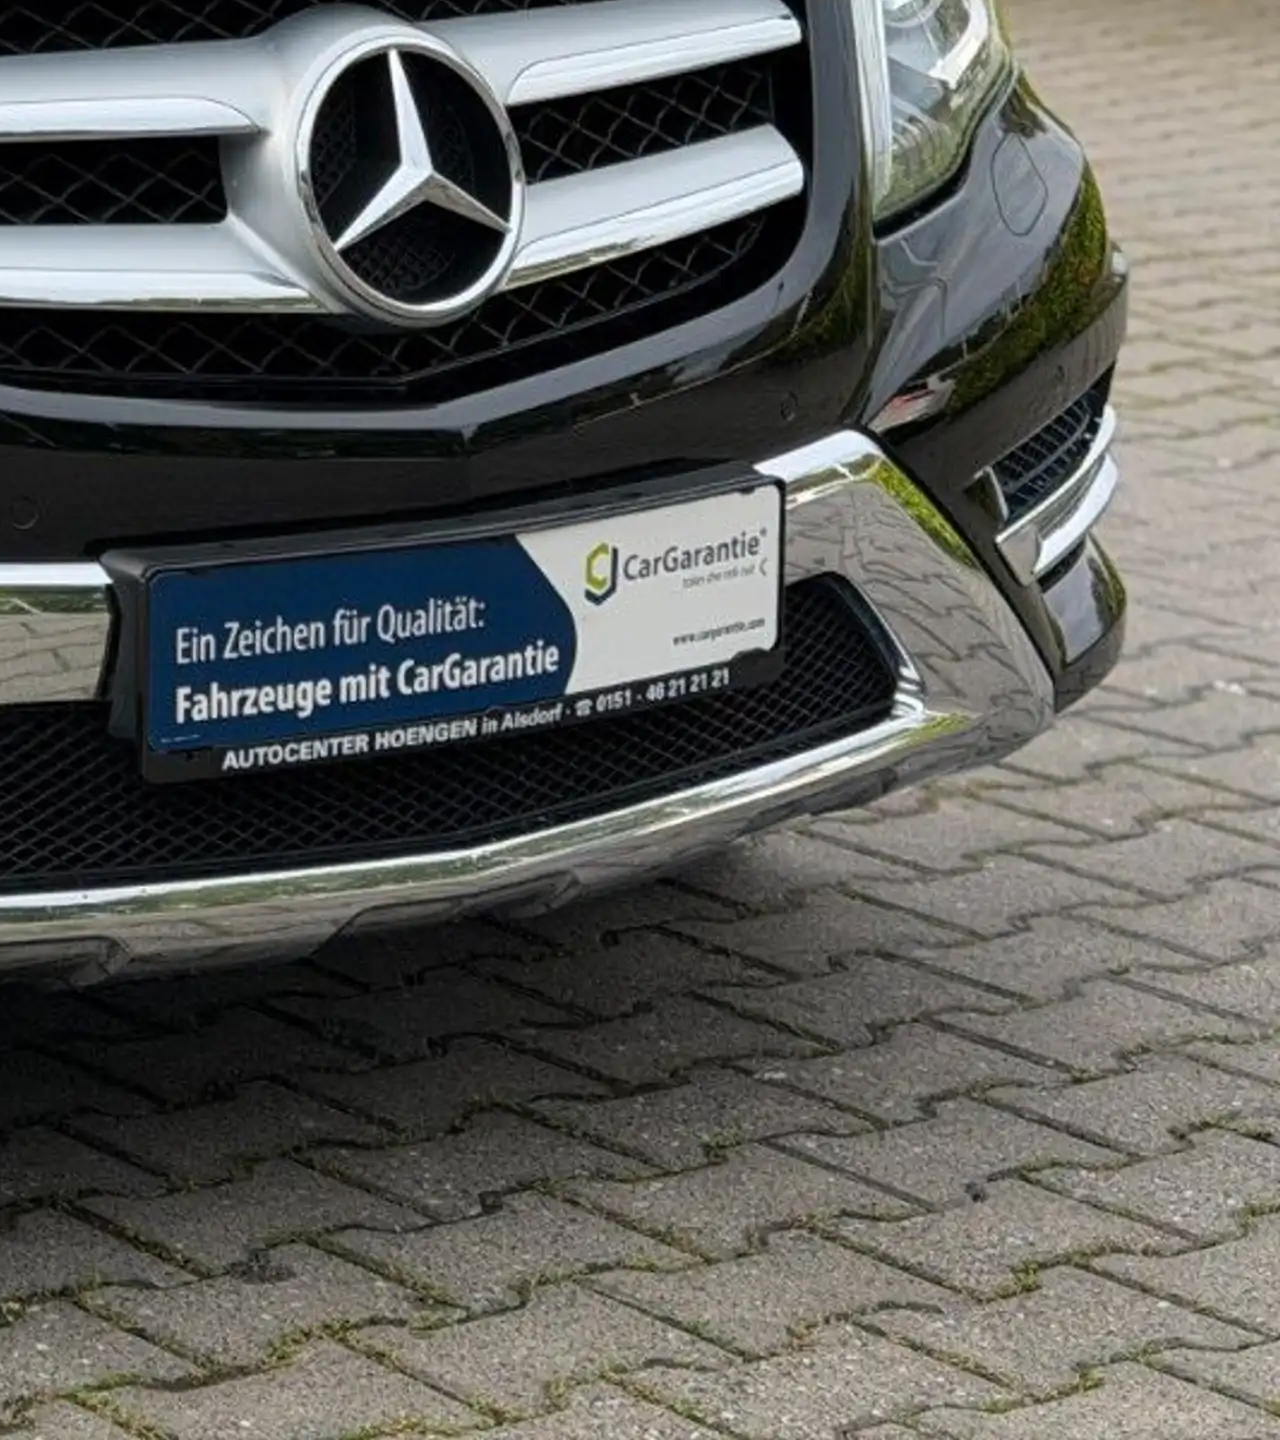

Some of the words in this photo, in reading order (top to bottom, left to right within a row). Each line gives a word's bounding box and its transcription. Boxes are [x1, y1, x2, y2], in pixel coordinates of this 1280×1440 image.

[175, 626, 216, 664] Ein
[223, 615, 325, 660] Zeichen
[333, 608, 371, 646] für
[376, 596, 486, 643] Qualität:
[175, 681, 333, 724] Fahrzeuge
[340, 663, 391, 704] mit
[396, 639, 559, 695] CarGarantie
[221, 733, 369, 771] AUTOCENTER
[375, 718, 477, 750] HOENGEN
[481, 717, 498, 734] in
[500, 703, 563, 731] Alsdorf
[596, 689, 632, 712] 0151
[667, 679, 686, 695] 21
[690, 673, 708, 691] 21
[711, 667, 730, 685] 21
